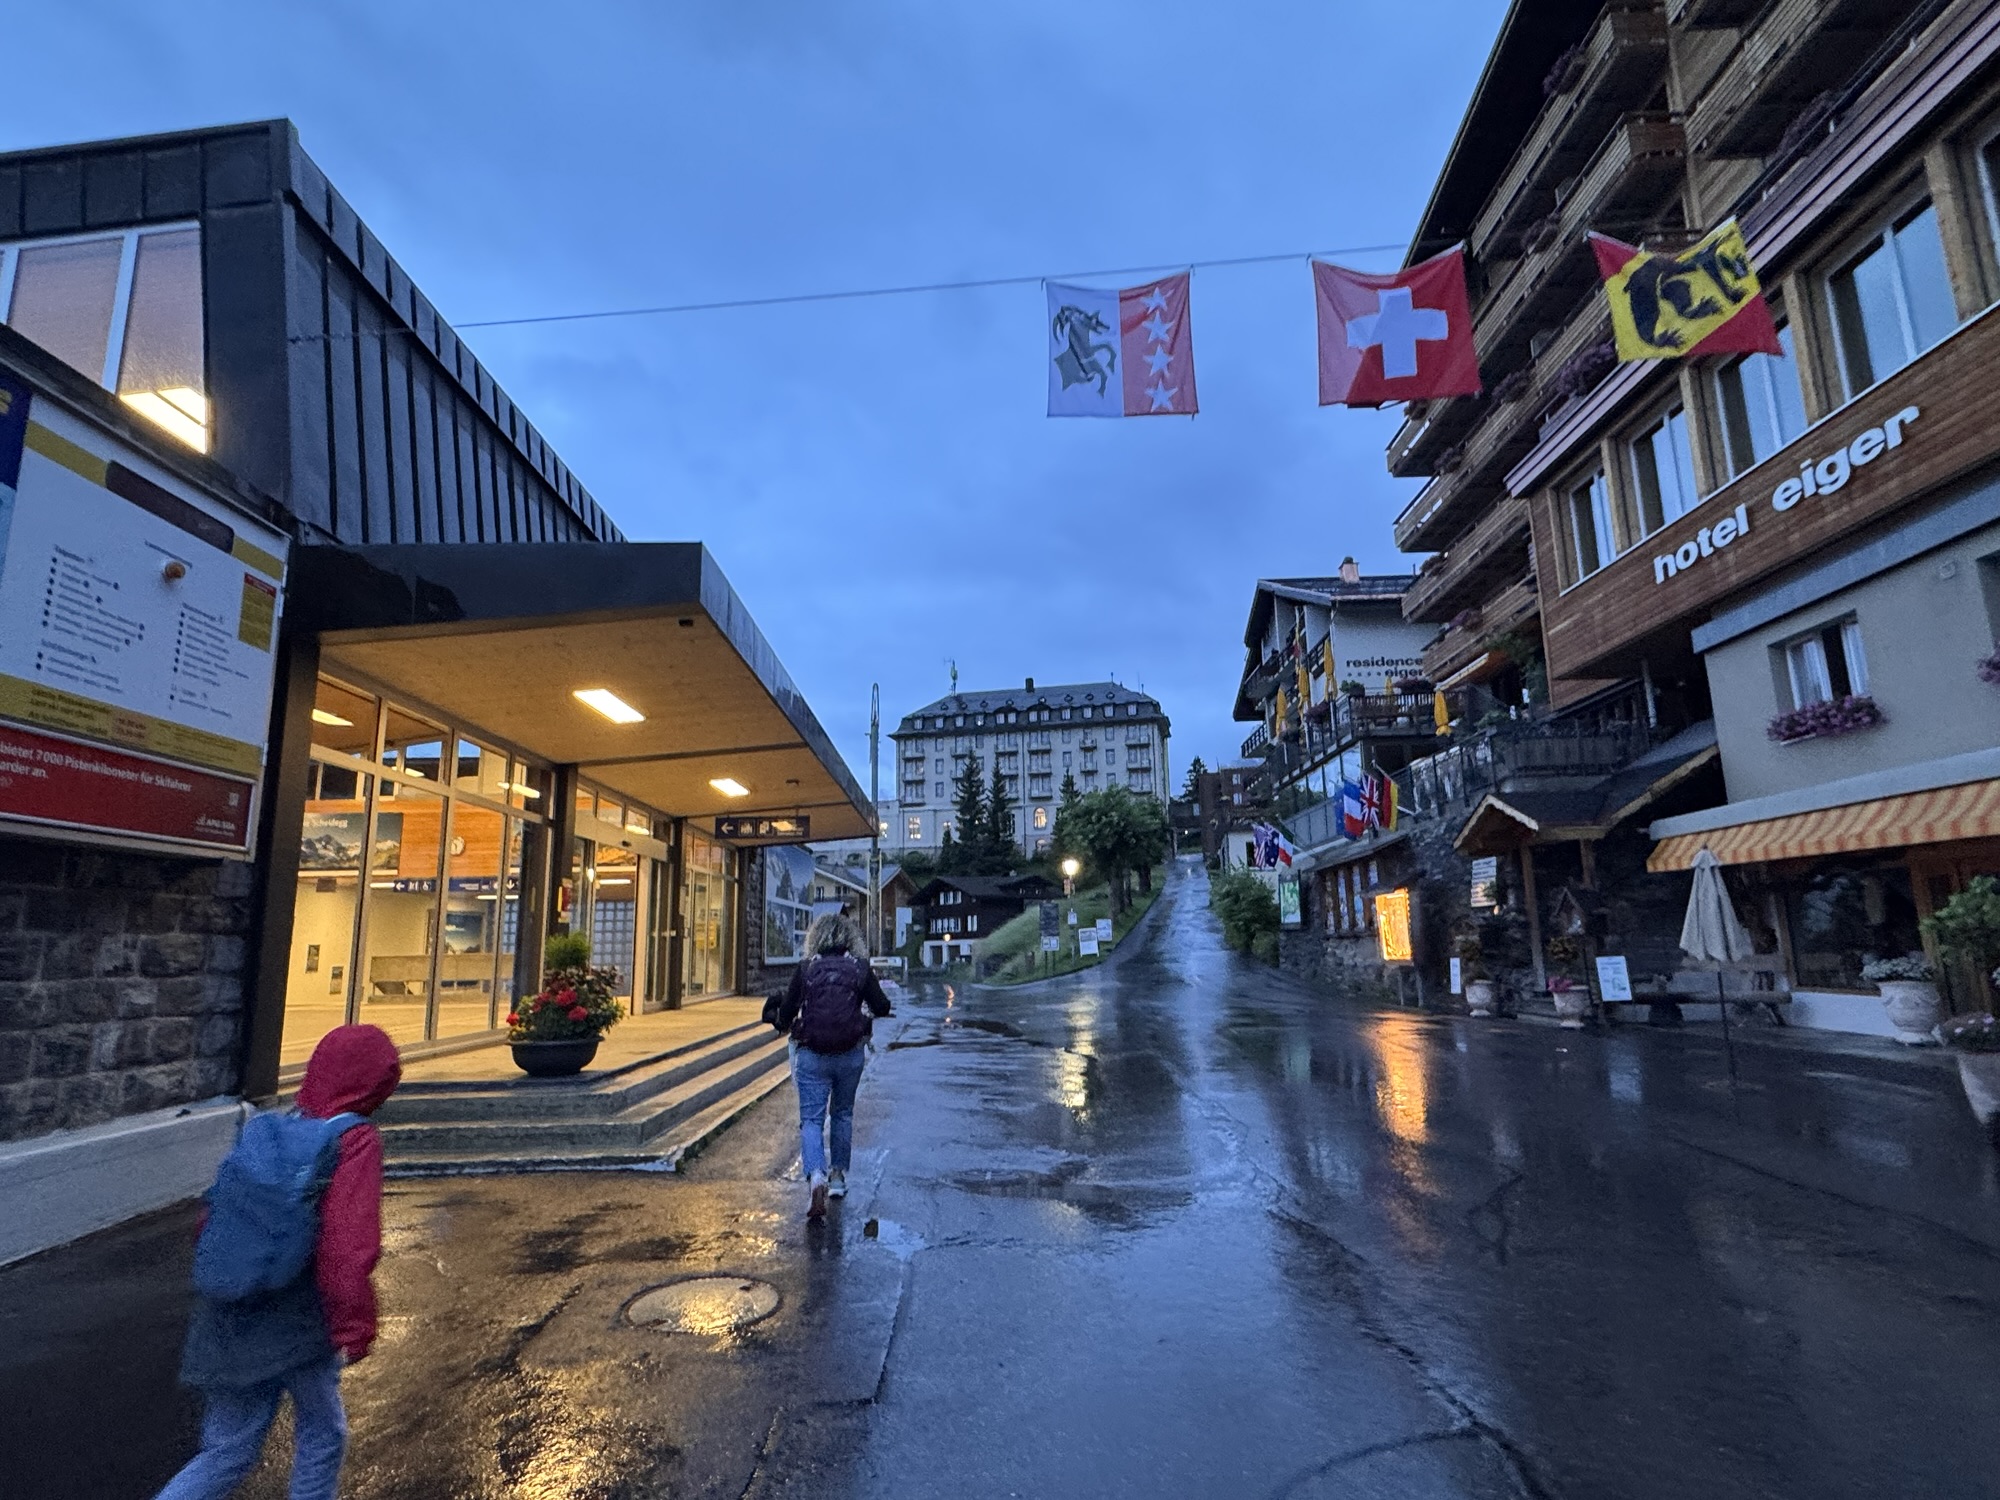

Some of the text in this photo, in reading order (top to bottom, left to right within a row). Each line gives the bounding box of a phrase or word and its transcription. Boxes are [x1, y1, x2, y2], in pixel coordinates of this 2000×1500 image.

[1653, 405, 1920, 585] hotel eiger
[1346, 656, 1422, 668] residence
[1384, 667, 1423, 679] eiger
